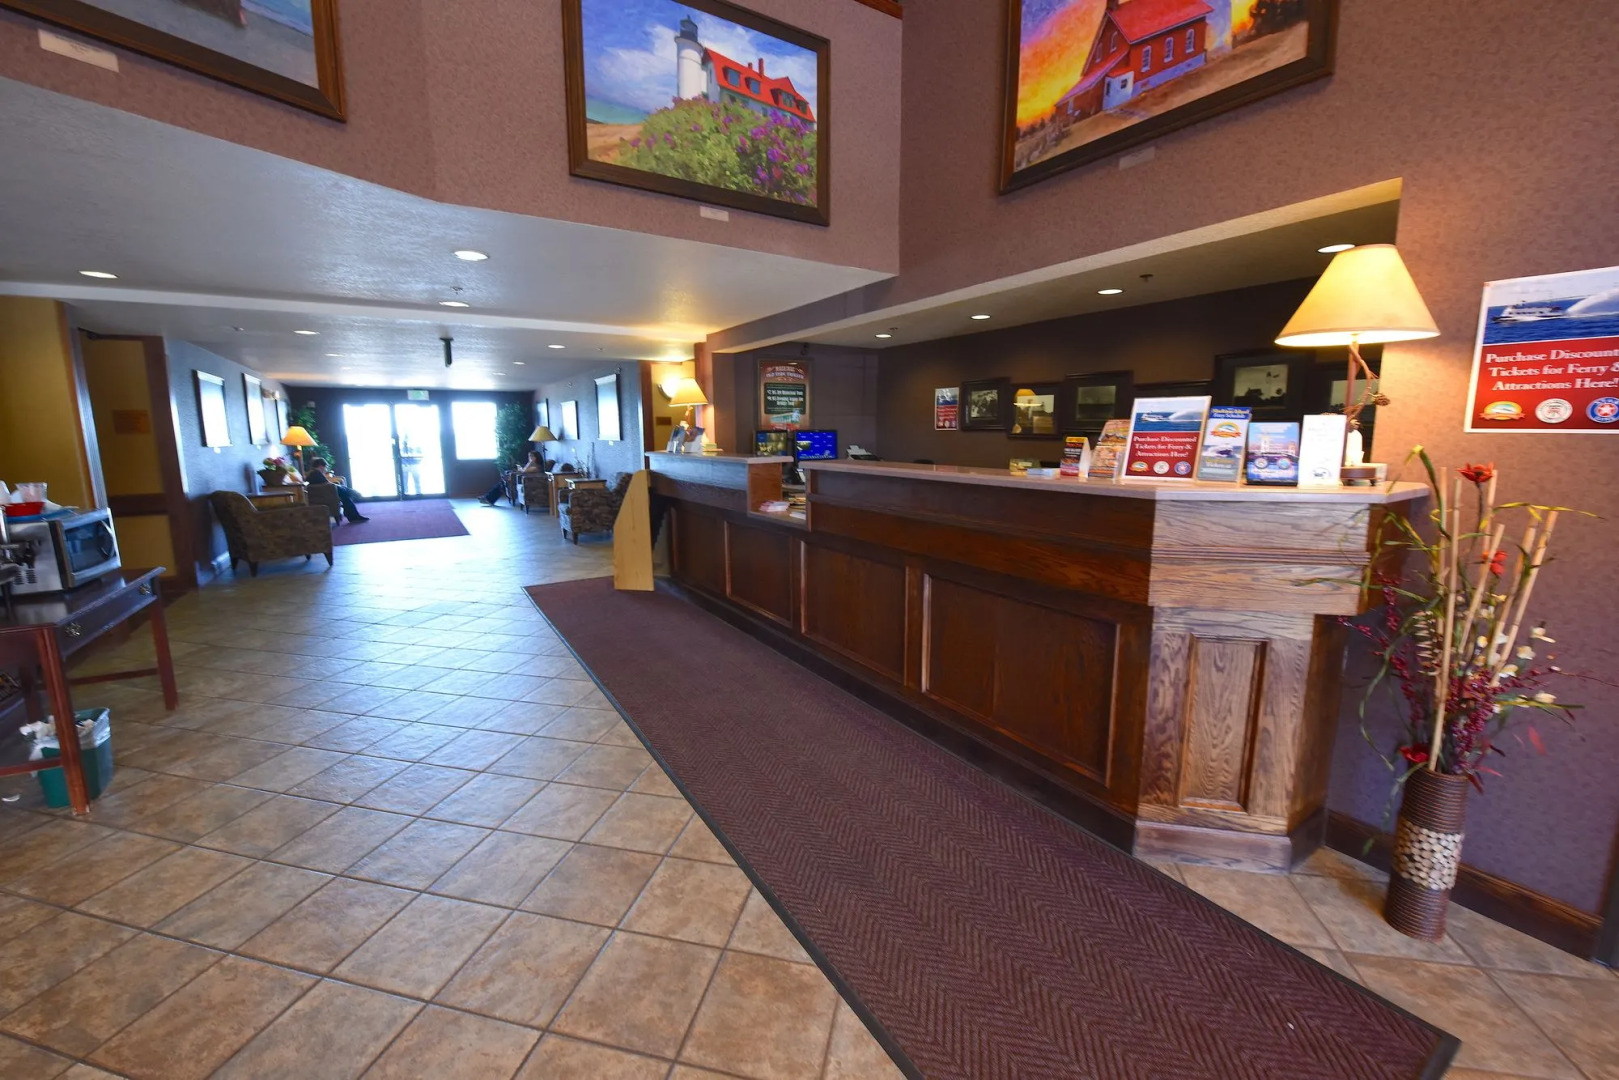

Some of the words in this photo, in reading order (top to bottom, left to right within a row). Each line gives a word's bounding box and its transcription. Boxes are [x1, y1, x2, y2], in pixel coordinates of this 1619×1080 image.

[1485, 352, 1547, 363] Purchase
[1488, 366, 1541, 377] Tickets
[1542, 364, 1565, 375] for
[1567, 363, 1609, 376] Ferry
[1492, 380, 1572, 391] Attractions
[1574, 377, 1619, 389] Here!
